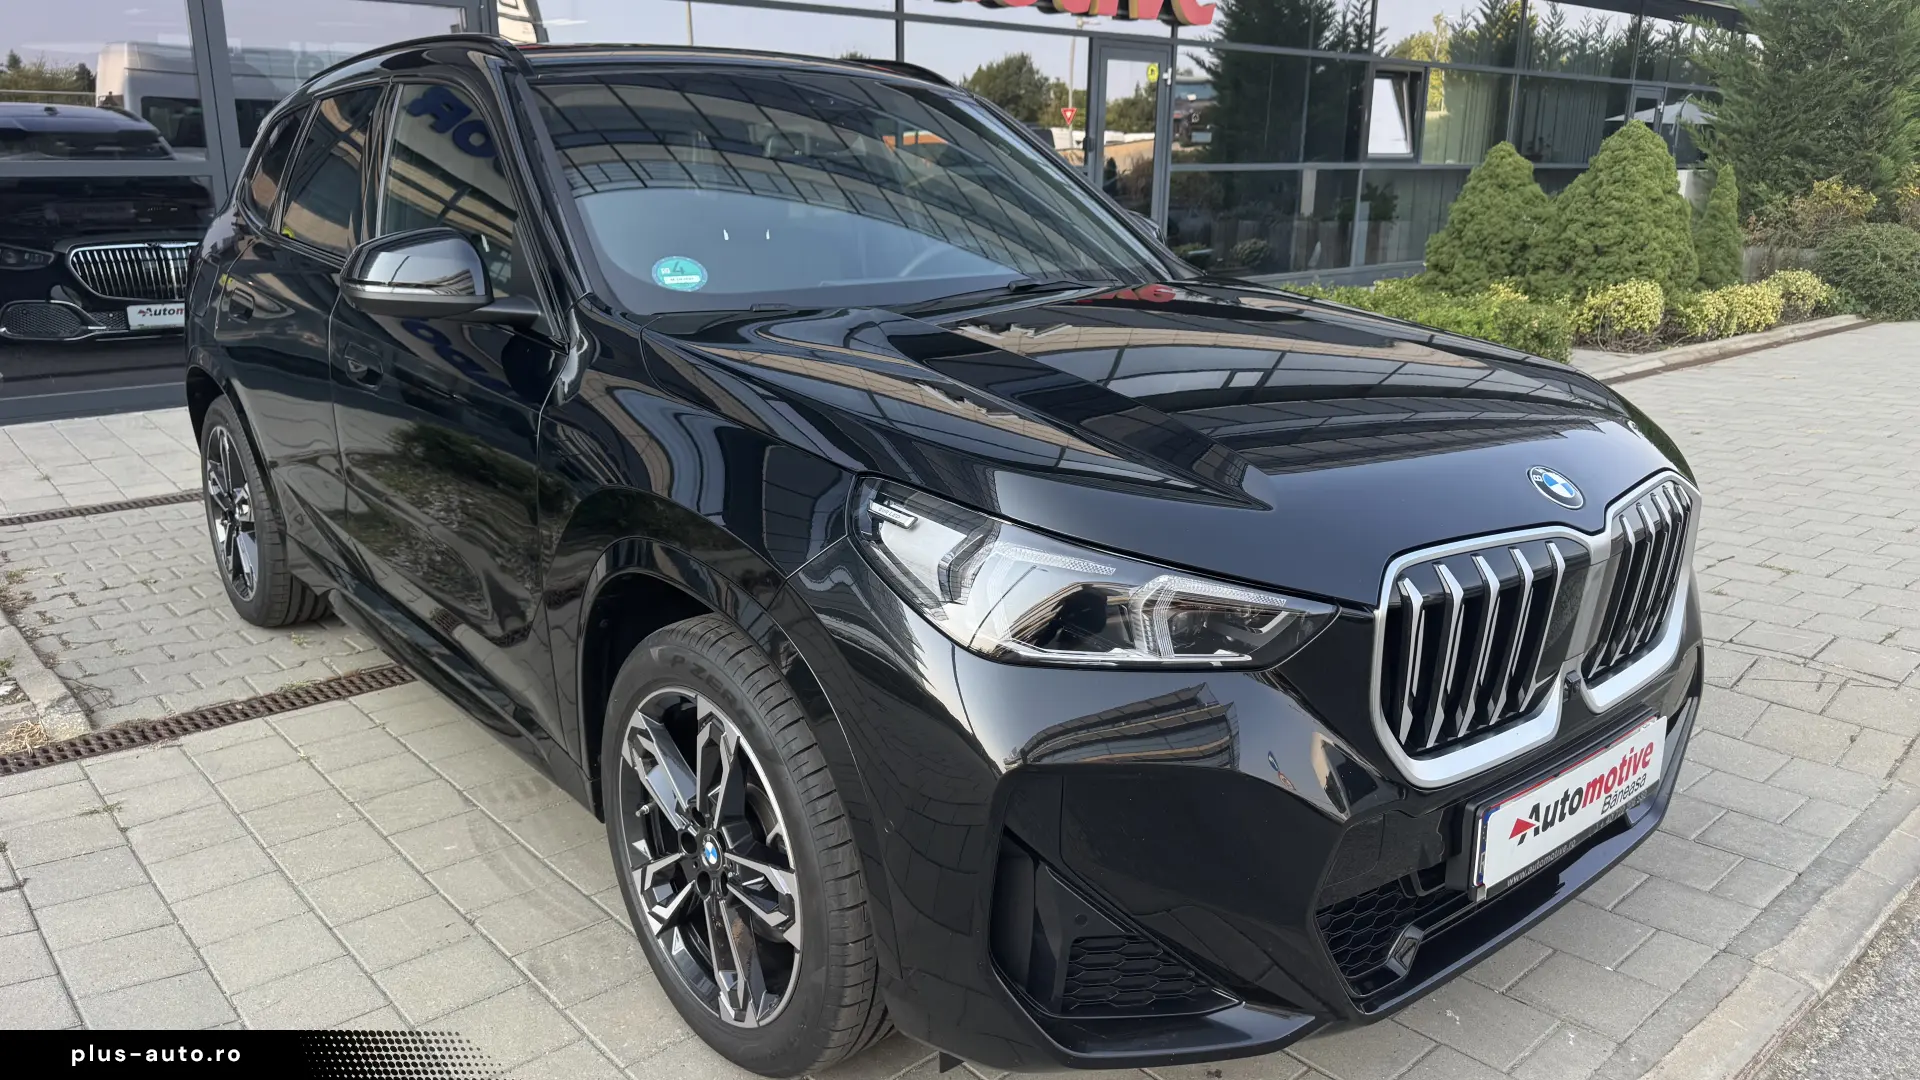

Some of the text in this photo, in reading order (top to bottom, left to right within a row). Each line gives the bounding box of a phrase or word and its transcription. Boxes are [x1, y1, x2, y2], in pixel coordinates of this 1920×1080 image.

[689, 662, 756, 732] ZERO
[1516, 741, 1654, 846] Automotive
[1600, 773, 1647, 815] Băneasa
[1507, 839, 1576, 887] www.automotive.ro
